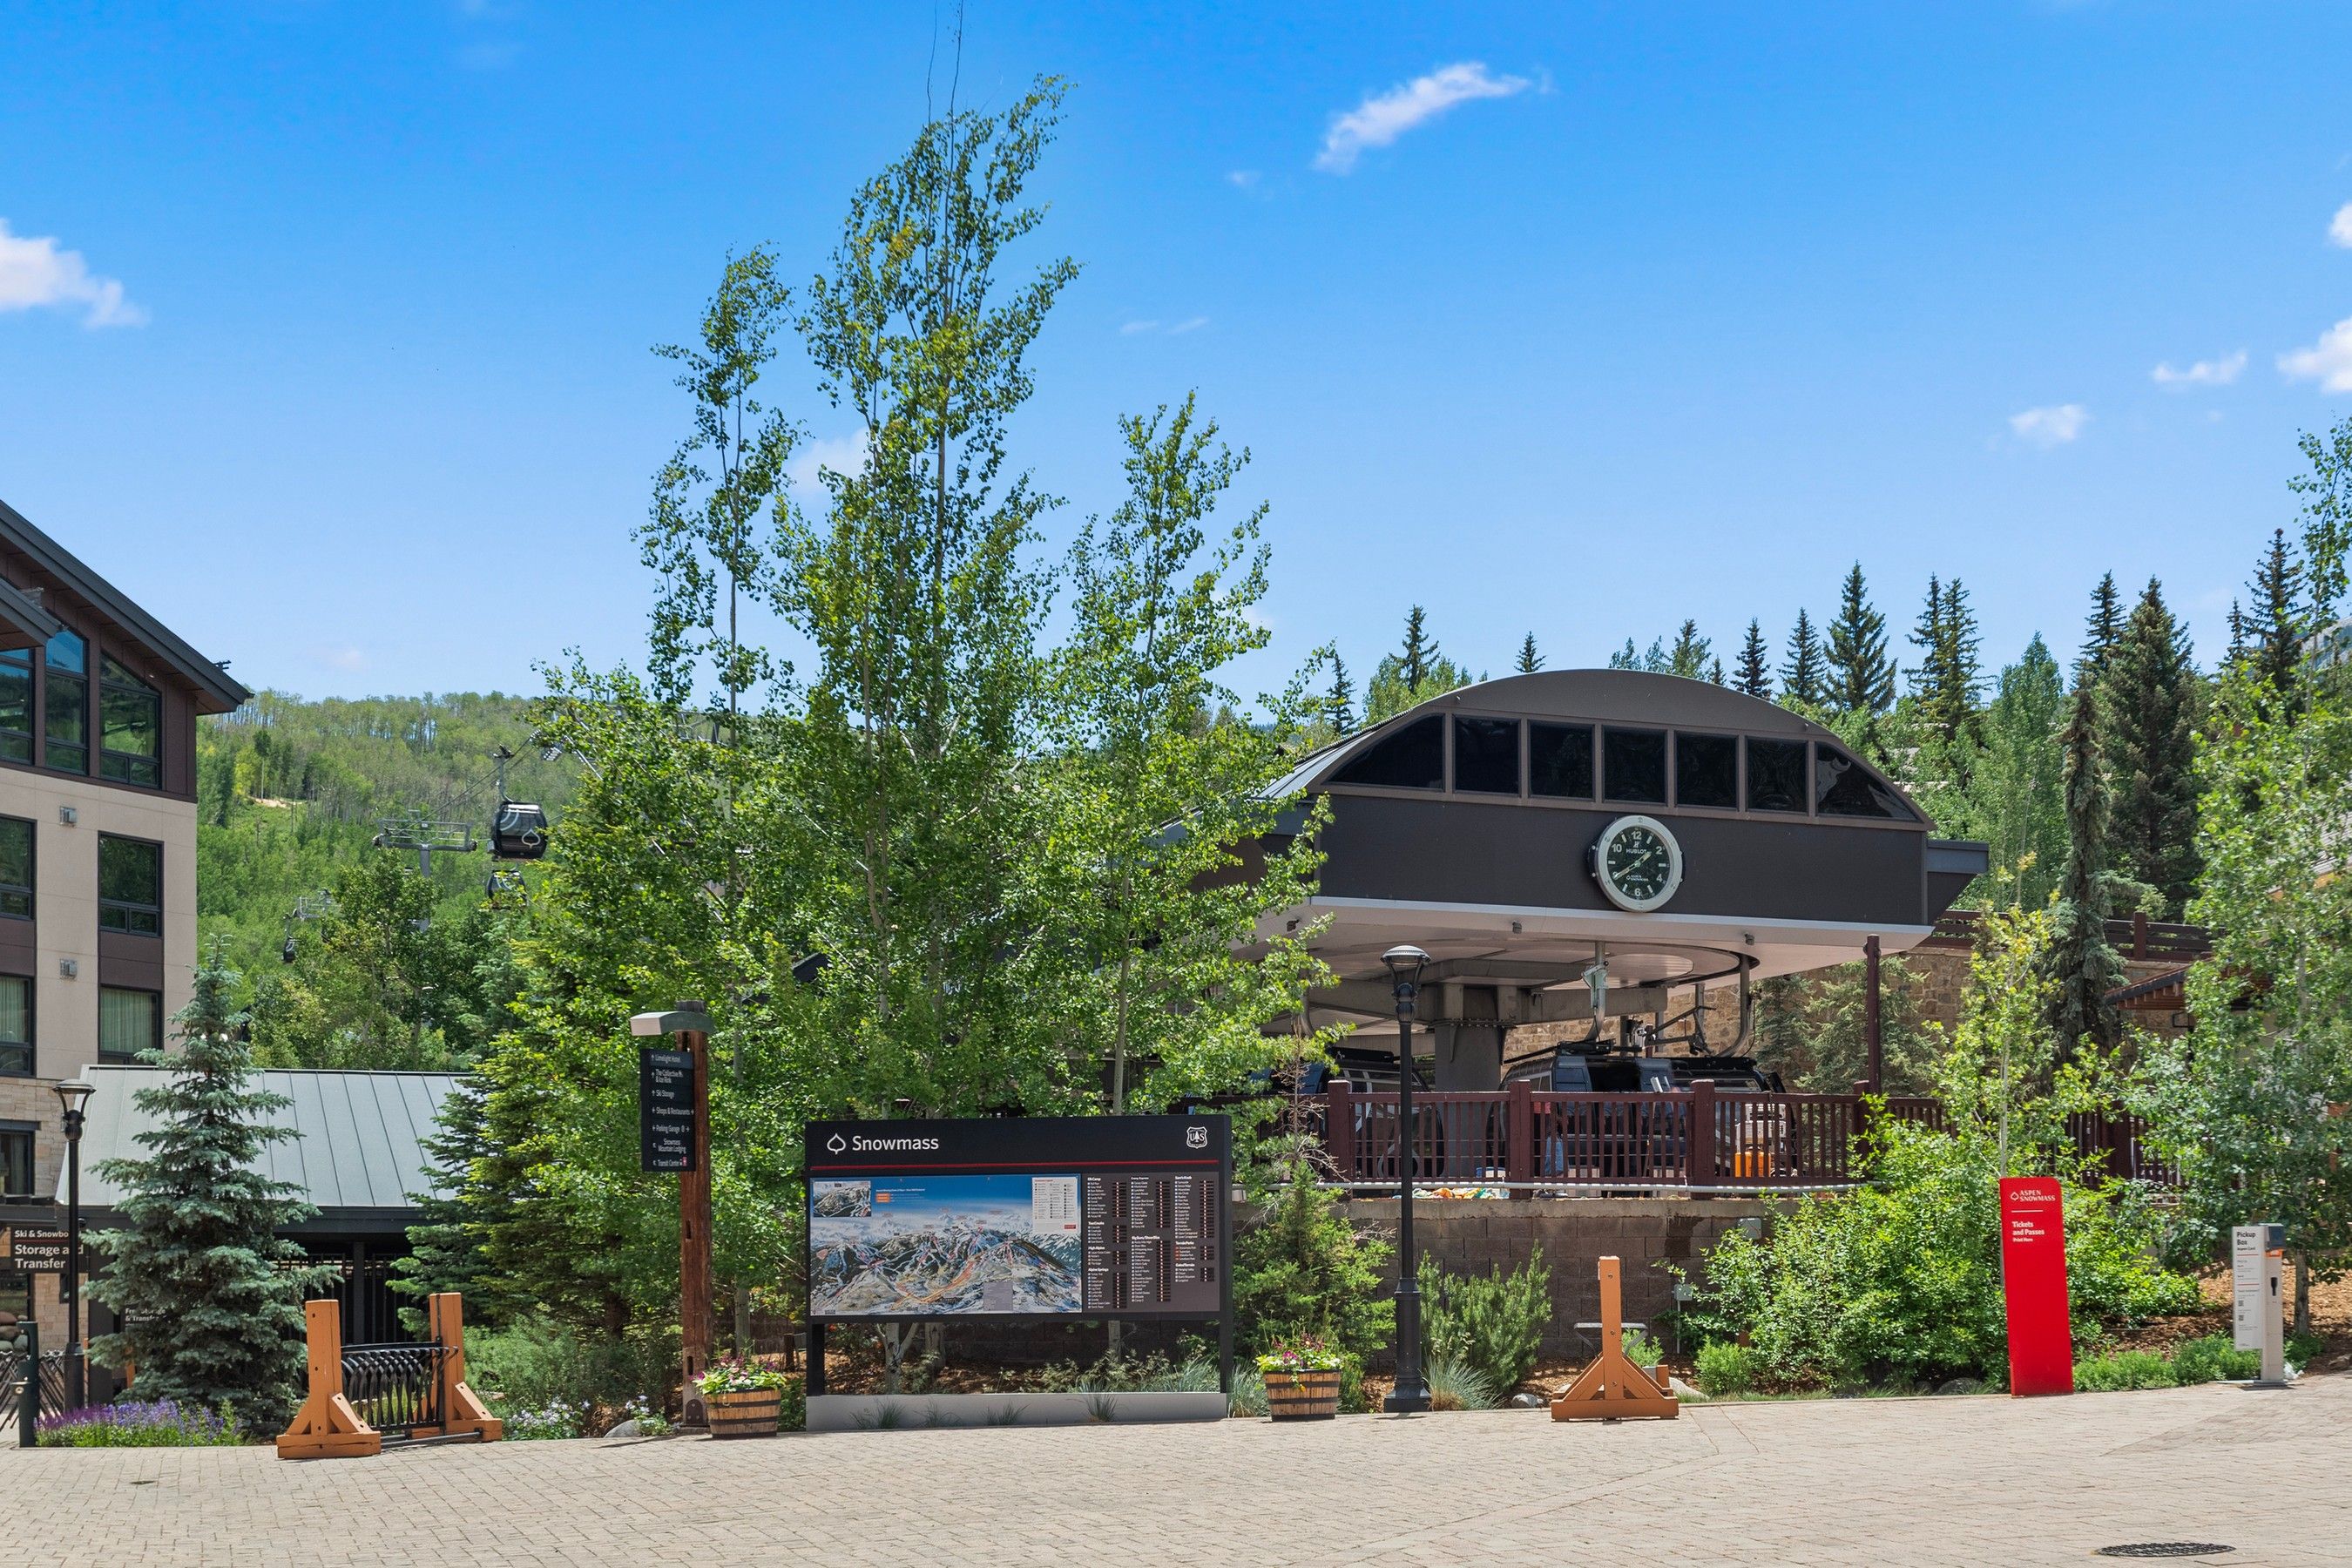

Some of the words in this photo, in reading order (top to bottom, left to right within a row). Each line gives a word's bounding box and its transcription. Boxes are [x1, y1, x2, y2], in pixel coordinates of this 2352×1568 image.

[1631, 830, 1642, 841] 12
[1611, 843, 1623, 853] 10
[1655, 846, 1663, 855] 2
[1656, 873, 1663, 882] 4
[1634, 888, 1641, 897] 6
[852, 1135, 939, 1151] Snowmass
[15, 1244, 60, 1257] Storage
[62, 1244, 84, 1255] ad
[15, 1258, 66, 1268] Transfer
